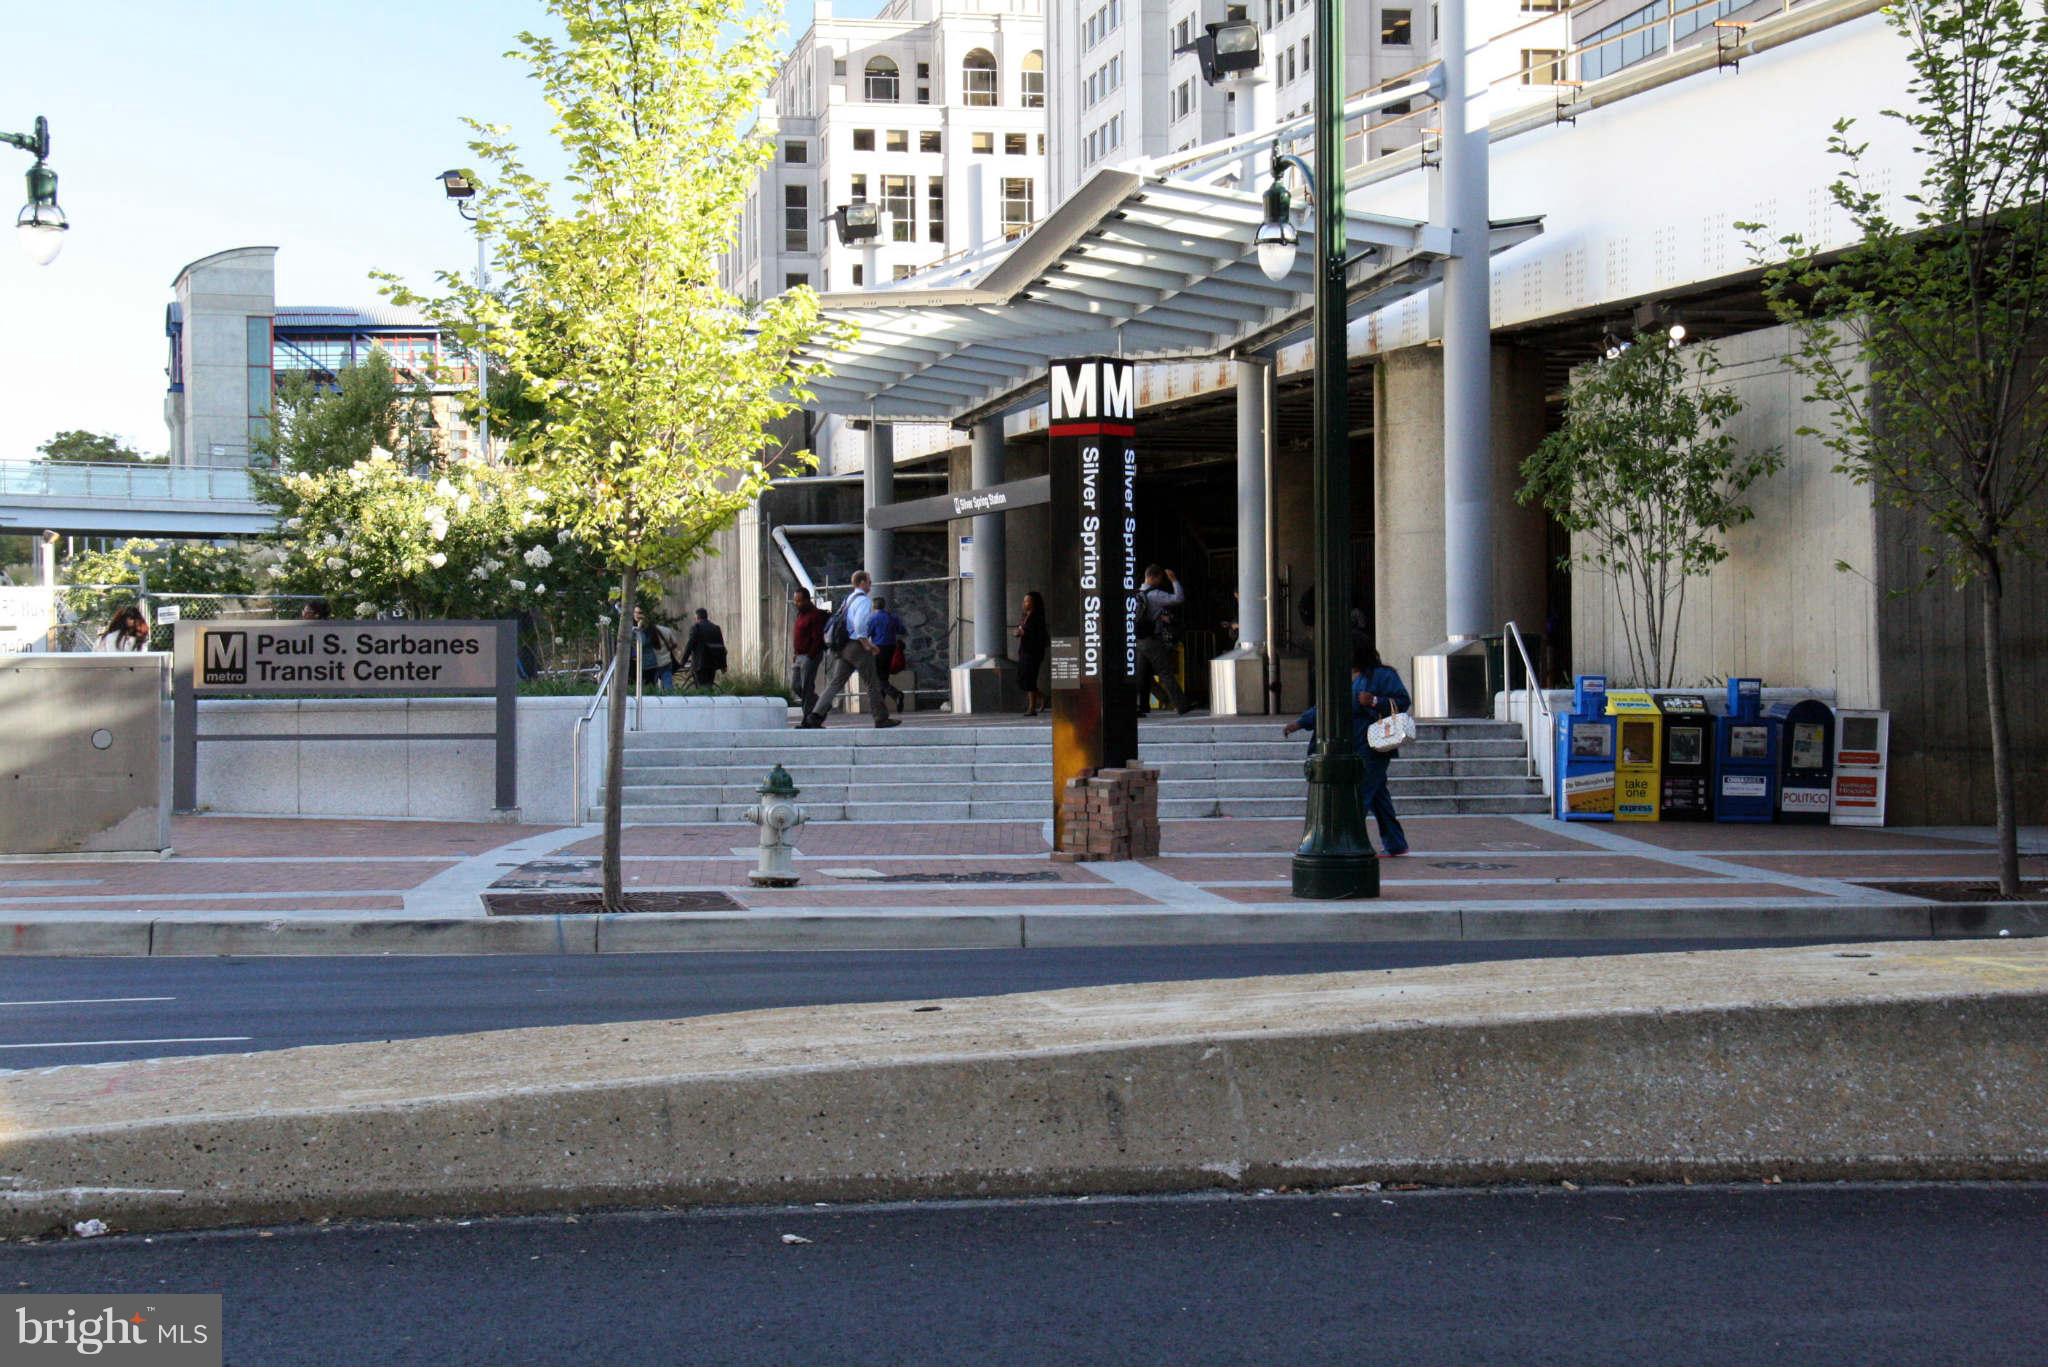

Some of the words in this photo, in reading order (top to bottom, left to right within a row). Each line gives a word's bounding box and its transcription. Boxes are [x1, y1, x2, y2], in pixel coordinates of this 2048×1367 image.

[1051, 363, 1097, 419] M
[1103, 363, 1134, 419] M
[973, 495, 990, 510] Spring
[988, 491, 1007, 505] Station
[1083, 446, 1100, 511] Silver
[1124, 448, 1137, 512] Silver
[1080, 516, 1100, 590] Spring
[1123, 517, 1137, 590] Spring
[256, 633, 314, 655] Paul
[323, 633, 347, 655] S.
[355, 633, 480, 655] Sarbanes
[1084, 596, 1101, 677] Station
[1126, 597, 1137, 677] Station
[206, 672, 245, 682] metro
[256, 659, 346, 681] Transit
[353, 659, 442, 681] Center
[1624, 778, 1649, 790] take
[1625, 789, 1647, 798] one
[1783, 792, 1828, 804] POLITICO
